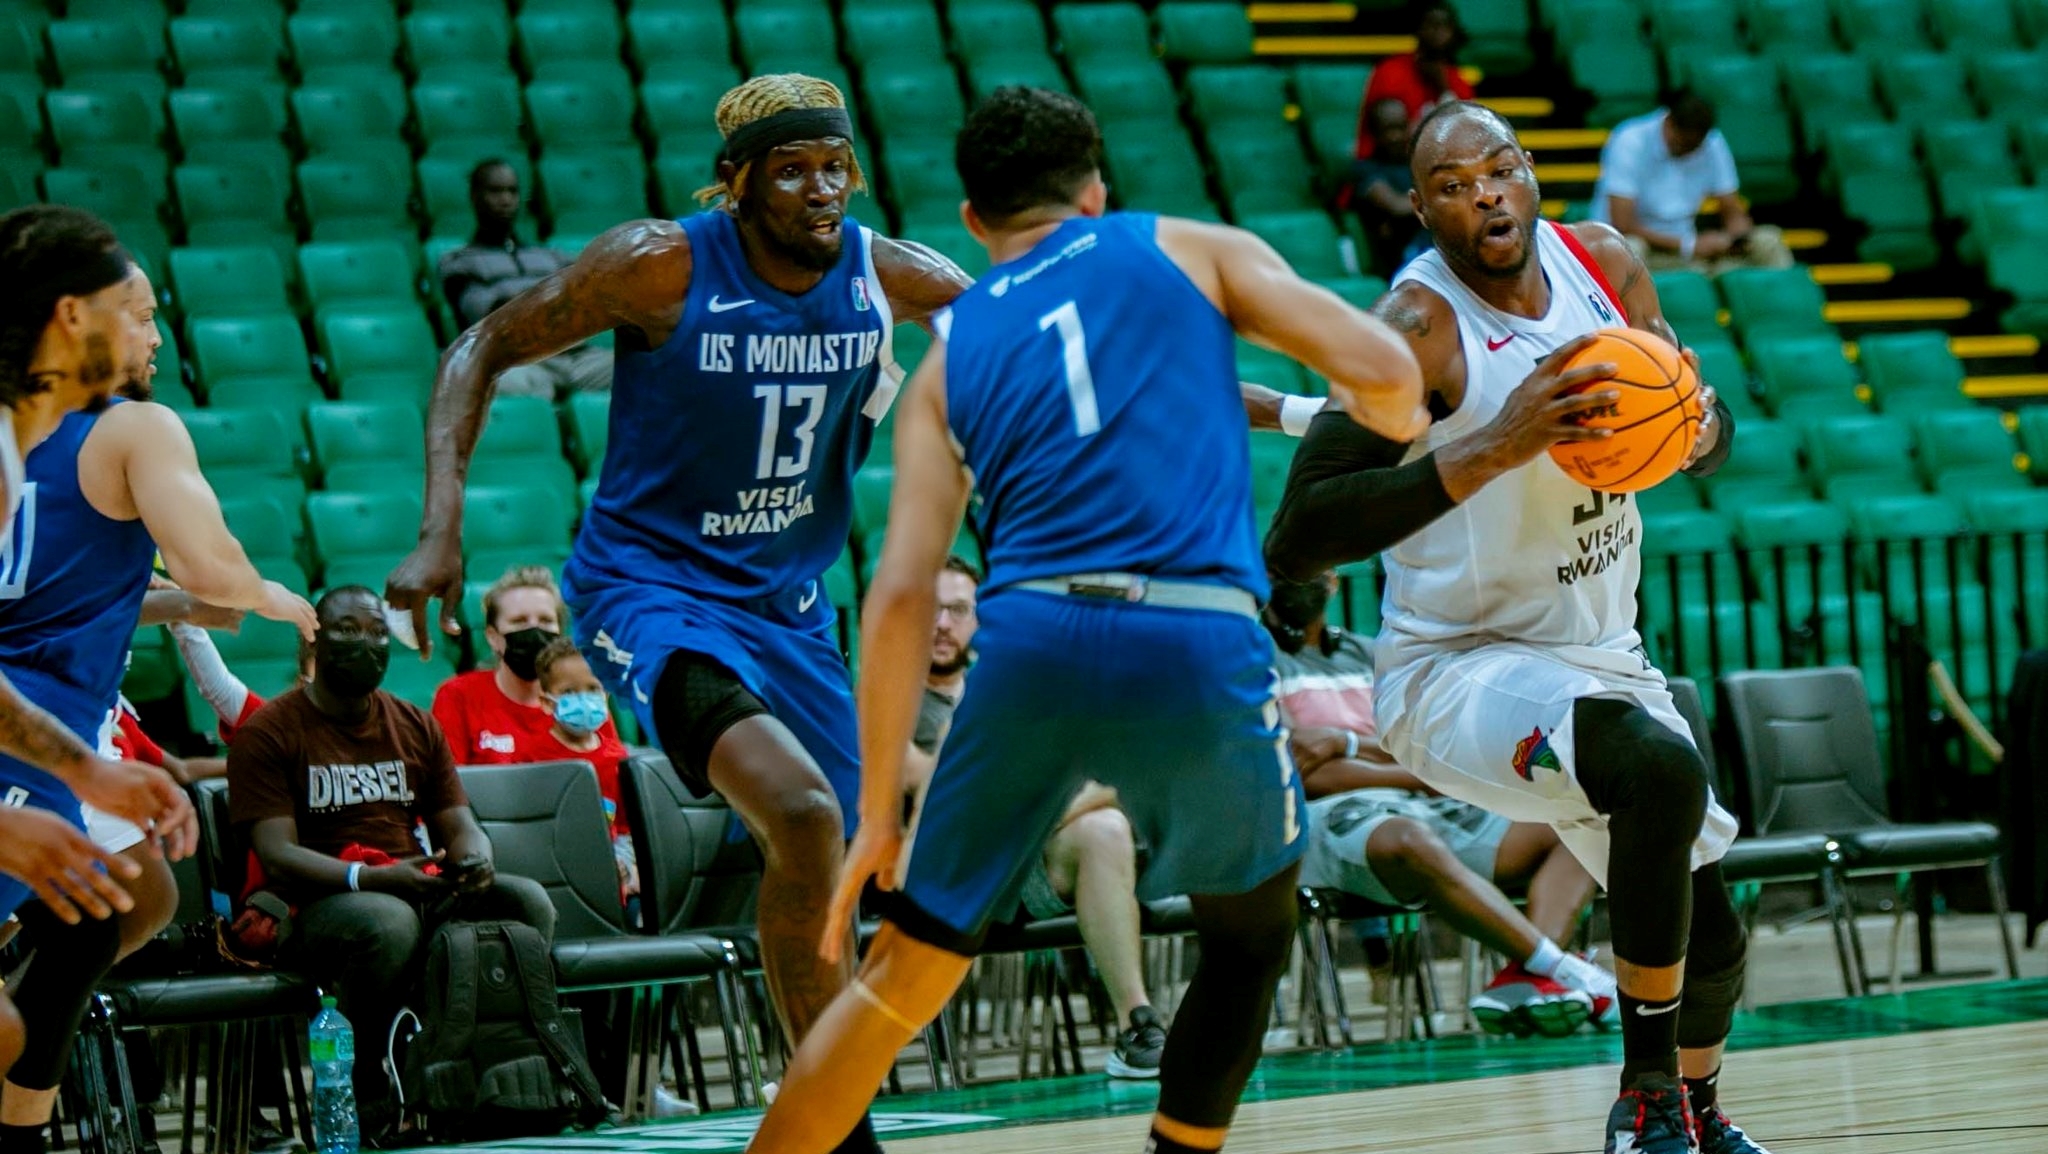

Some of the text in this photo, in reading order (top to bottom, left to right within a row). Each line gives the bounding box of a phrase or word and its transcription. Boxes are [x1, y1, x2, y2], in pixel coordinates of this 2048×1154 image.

[700, 329, 880, 373] US MONASTIR
[1039, 300, 1101, 438] 1
[753, 384, 828, 479] 13
[701, 494, 815, 537] RWANDA
[736, 479, 806, 511] VISIT
[1577, 512, 1626, 554] VISIT
[308, 760, 415, 809] DIESEL
